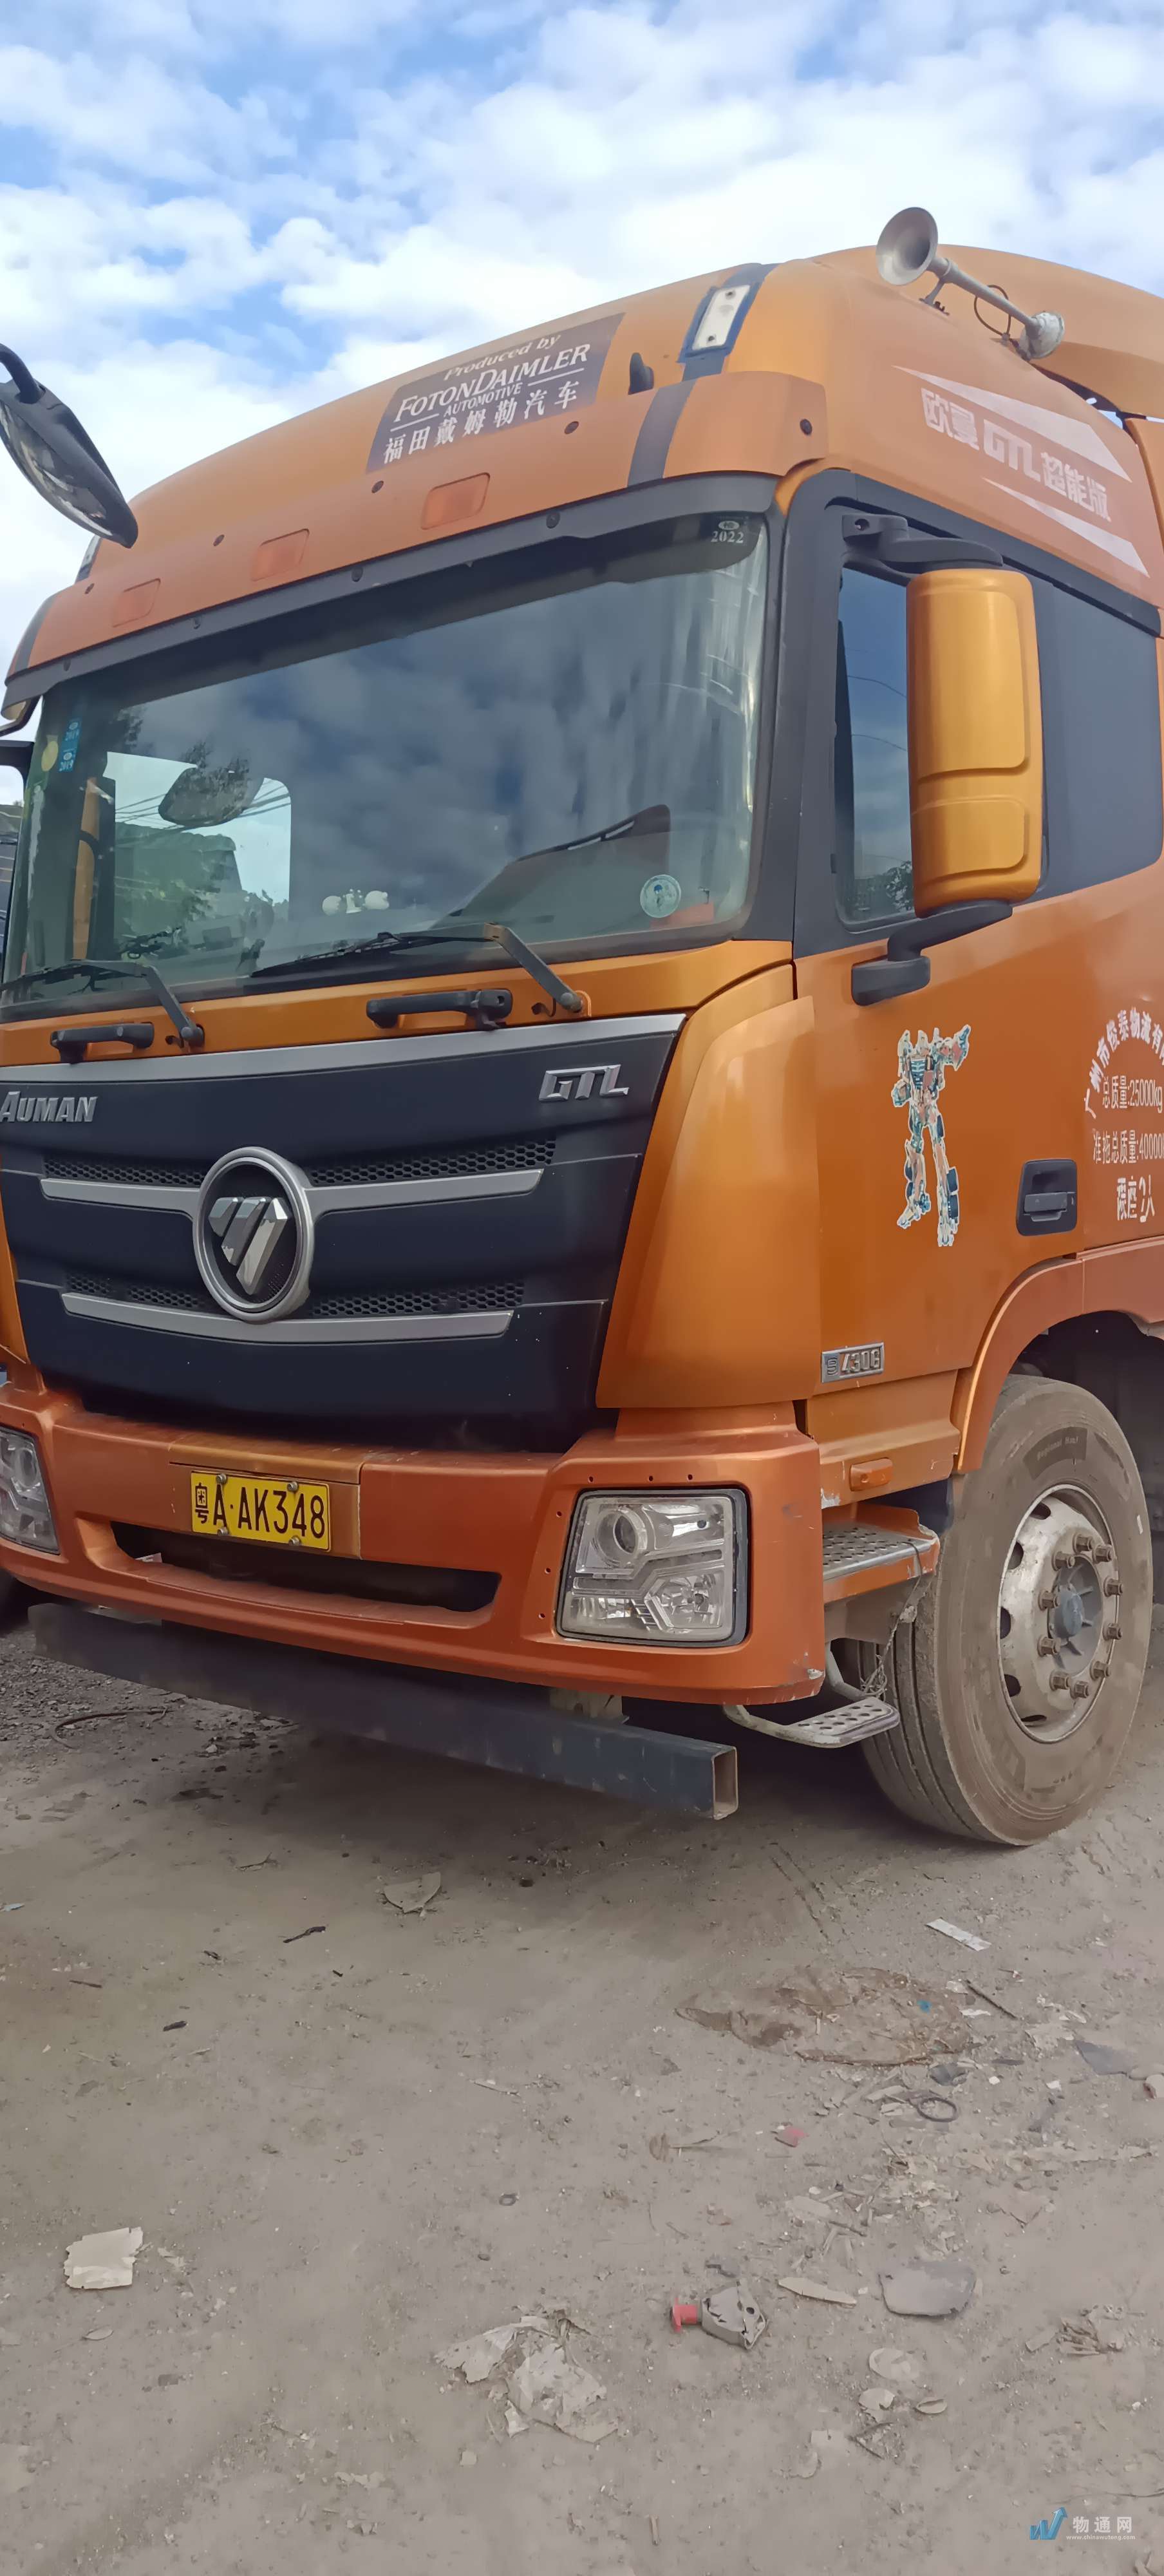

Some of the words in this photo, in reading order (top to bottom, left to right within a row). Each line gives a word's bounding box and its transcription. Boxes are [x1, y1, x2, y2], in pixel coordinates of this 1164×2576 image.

[444, 343, 529, 381] Produced
[536, 334, 561, 351] by
[444, 383, 523, 417] AUTOMOTIVE
[384, 381, 579, 464] 福田戴姆勒汽车
[921, 388, 979, 450] 欧曼
[983, 419, 1041, 482] GTL
[1040, 451, 1111, 522] 超能版
[710, 530, 744, 544] 2022
[539, 1064, 630, 1101] GTL
[0, 1091, 98, 1122] AUMAN
